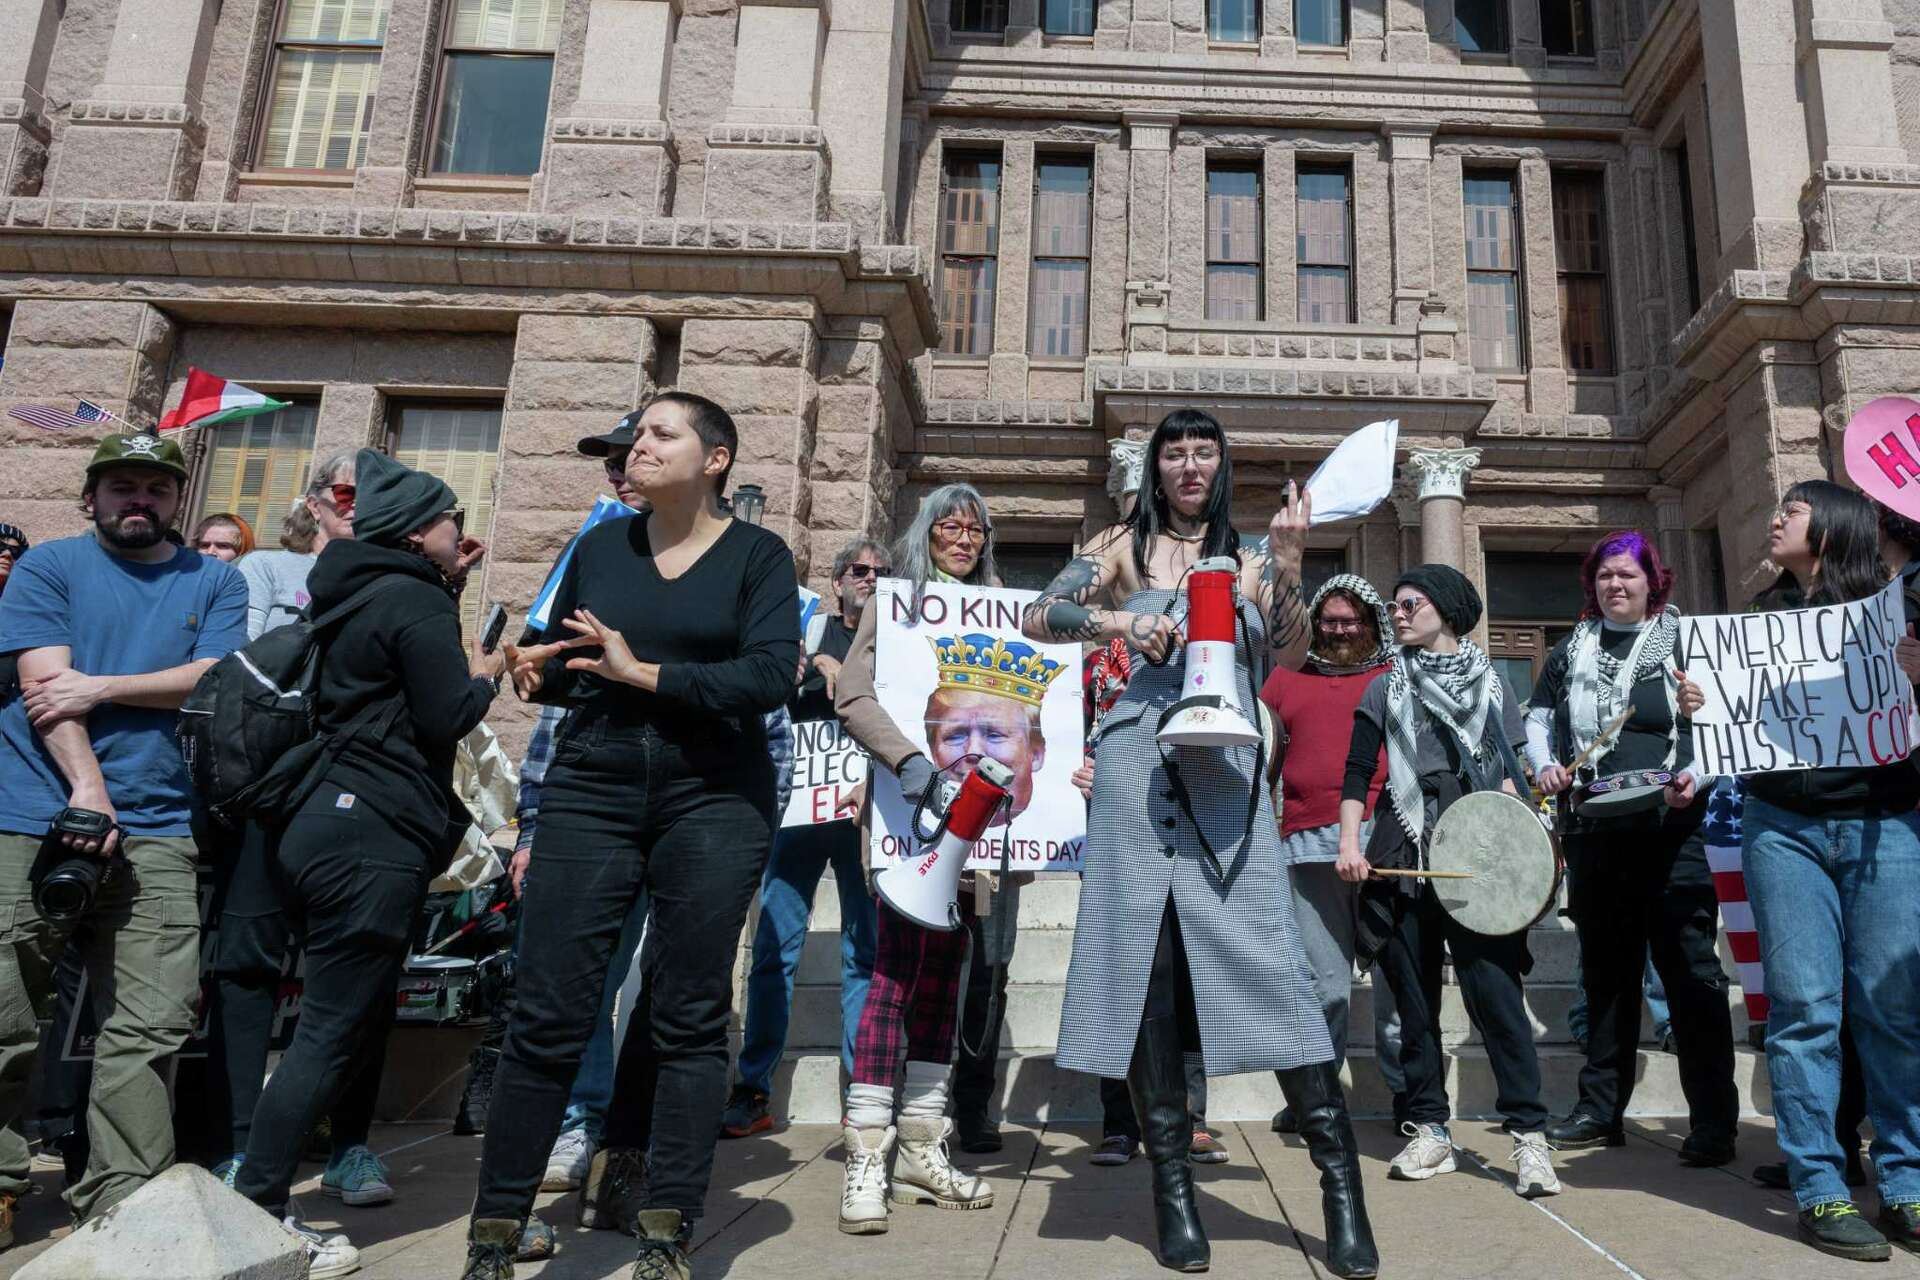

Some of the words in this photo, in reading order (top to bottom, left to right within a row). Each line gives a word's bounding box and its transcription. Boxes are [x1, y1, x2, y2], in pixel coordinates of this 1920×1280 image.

[892, 592, 947, 625] NO
[961, 597, 1020, 630] KIN
[1713, 664, 1825, 726] WAKE
[1843, 650, 1900, 715] UP!
[796, 721, 866, 757] NOB
[1692, 718, 1777, 775] THIS
[1781, 716, 1824, 768] IS
[1836, 716, 1863, 766] A
[881, 834, 912, 857] ON
[919, 838, 1040, 861] IDENTS
[1047, 840, 1083, 862] DAY
[918, 850, 938, 876] PYLE
